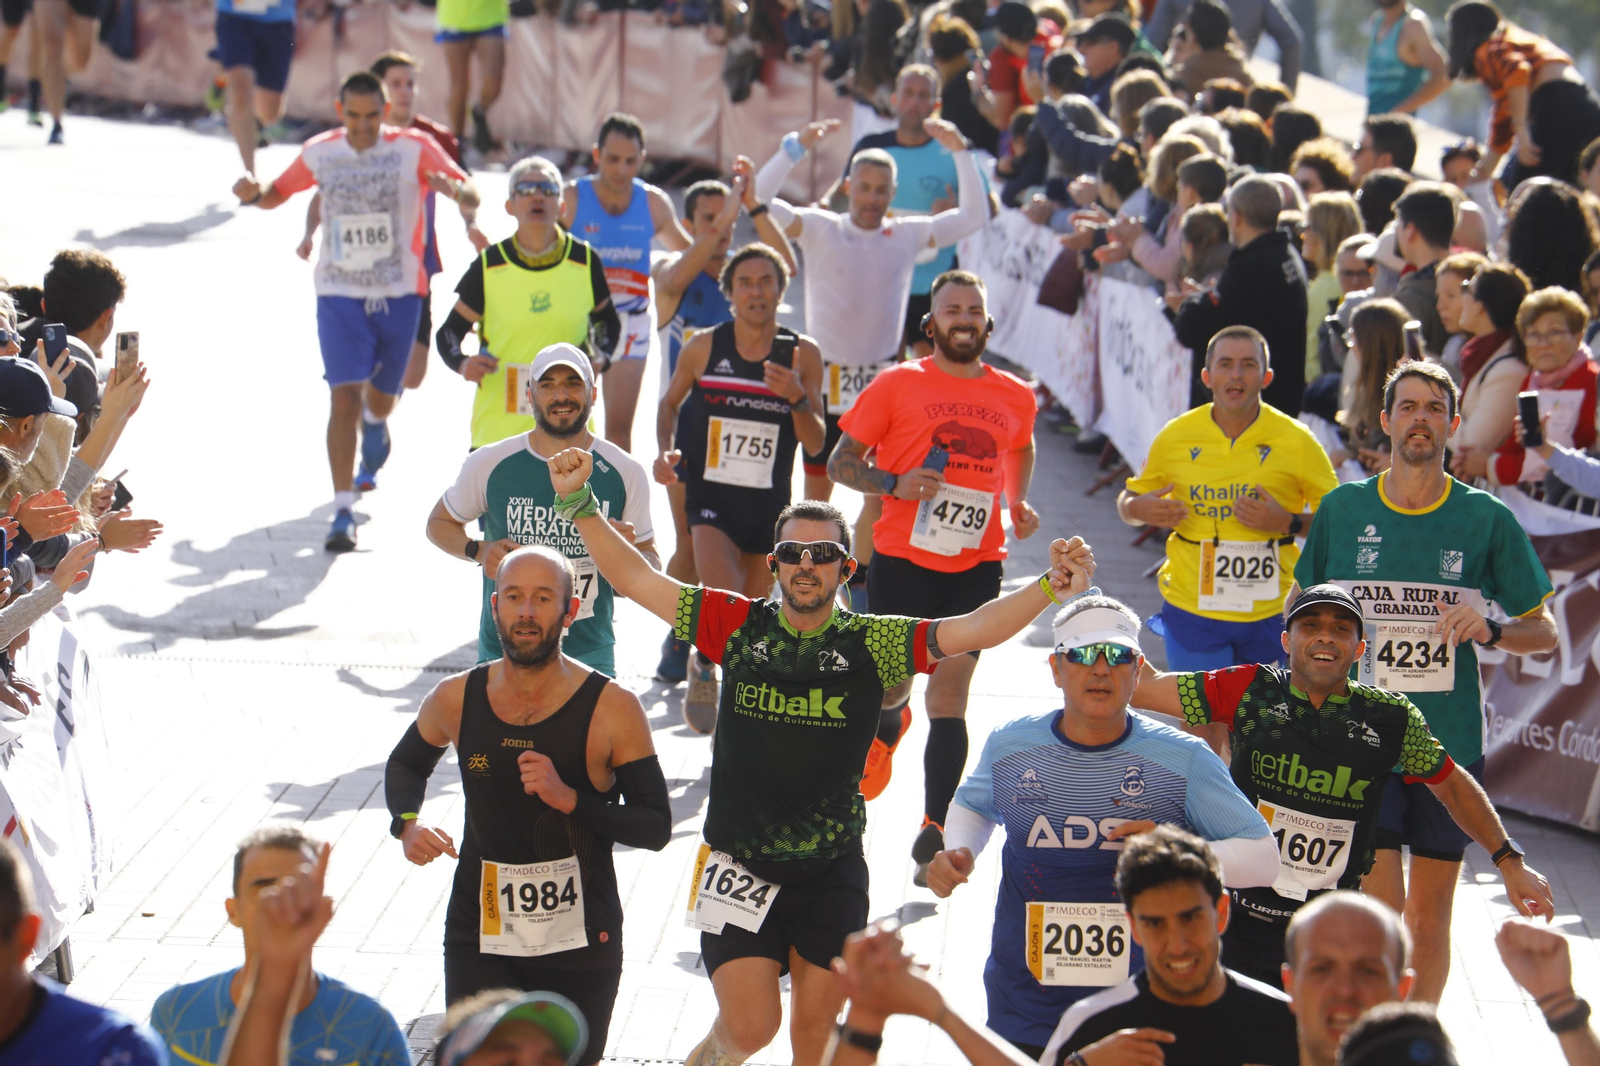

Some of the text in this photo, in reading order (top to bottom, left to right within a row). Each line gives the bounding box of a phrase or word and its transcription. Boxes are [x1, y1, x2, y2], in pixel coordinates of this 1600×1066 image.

[343, 225, 389, 246] 4186
[924, 402, 1009, 431] PEREZA
[722, 433, 773, 459] 1755
[945, 458, 969, 470] NING
[508, 496, 533, 506] XXXII
[947, 487, 976, 500] IMDECO
[1189, 483, 1260, 501] Khalifa
[932, 499, 987, 530] 4739
[1194, 503, 1234, 521] Cap
[507, 519, 582, 536] MARATO
[507, 534, 586, 546] INTERNACIONA
[1215, 555, 1275, 580] 2026
[1352, 586, 1461, 605] CAJA RURAL
[1373, 603, 1441, 616] GRANADA
[1388, 625, 1426, 635] IMDECO
[1376, 639, 1450, 669] 4234
[734, 705, 847, 728] Centro de Quiromasaje
[1558, 719, 1600, 764] Córdo
[1251, 775, 1365, 810] Centro de Quiromasaje
[1026, 814, 1138, 850] ADS
[1285, 814, 1325, 831] IMDECO
[1273, 828, 1346, 868] 1607
[509, 865, 550, 876] IMDECO
[500, 876, 578, 913] 1984
[704, 863, 772, 909] 1624
[1056, 906, 1097, 916] IMDECO
[1031, 931, 1039, 963] CAJÓN
[1043, 922, 1125, 957] 2036
